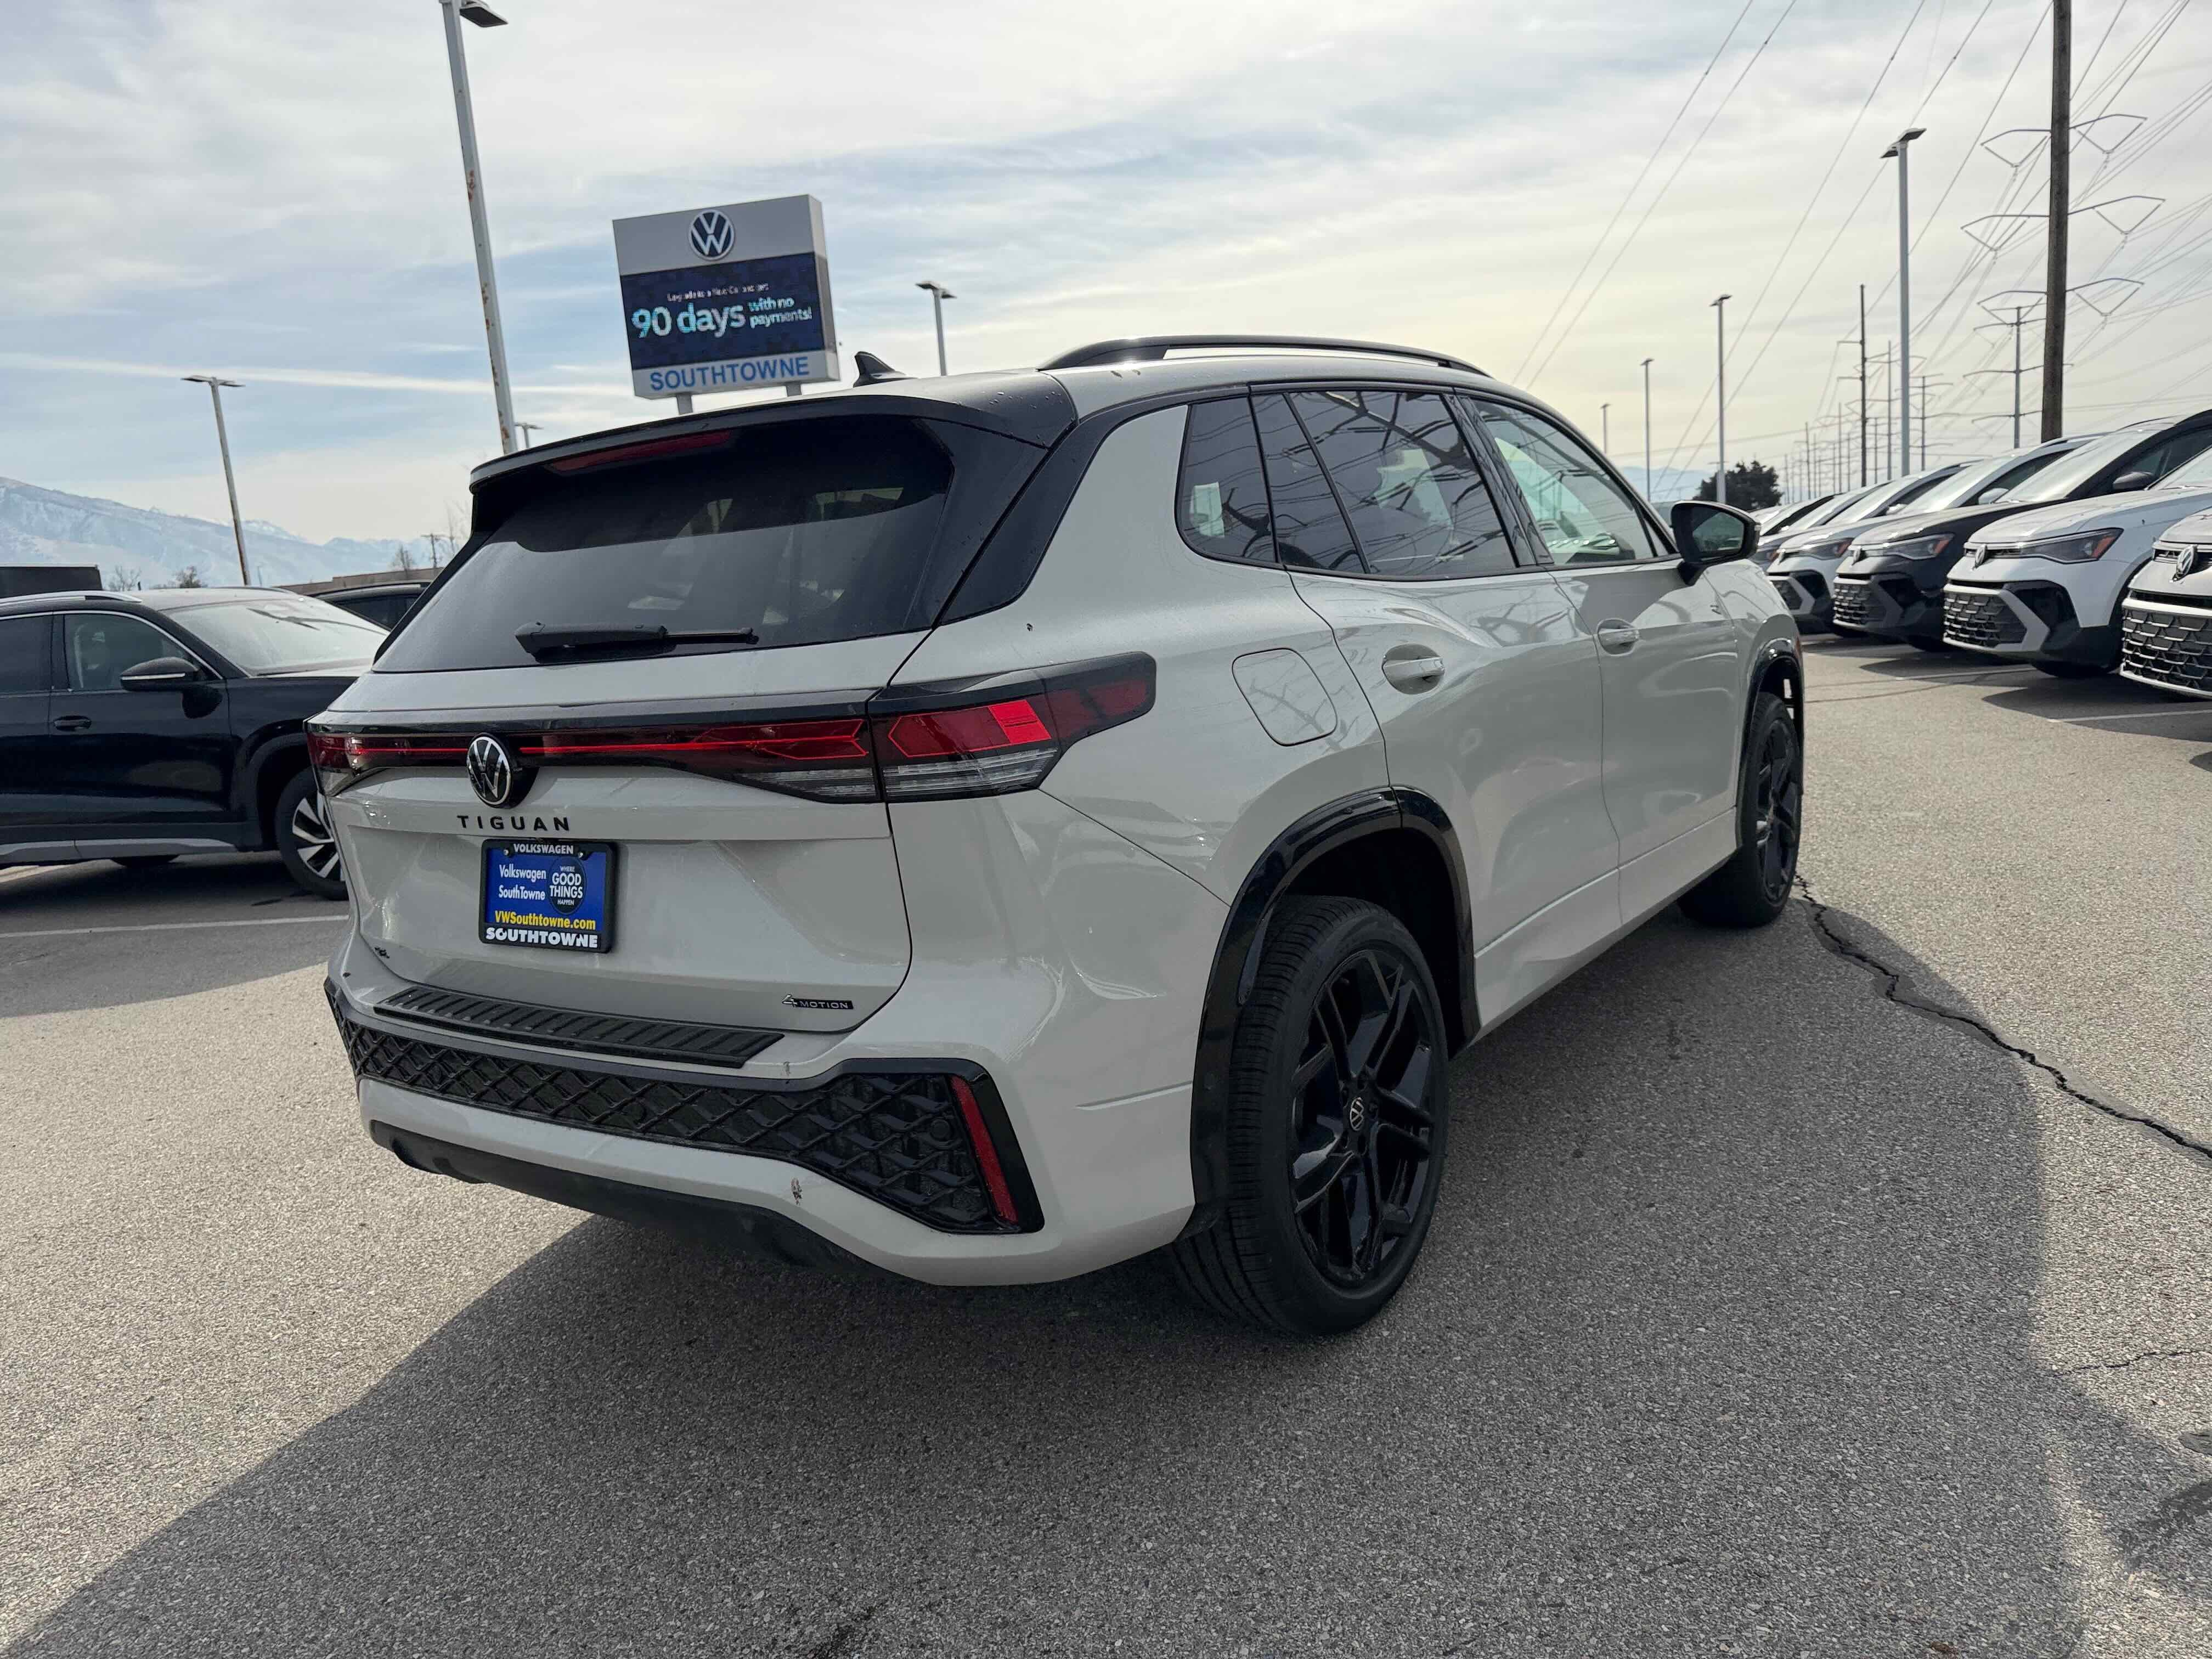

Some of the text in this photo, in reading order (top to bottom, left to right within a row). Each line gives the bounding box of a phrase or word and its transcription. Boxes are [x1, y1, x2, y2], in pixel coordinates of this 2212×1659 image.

[689, 210, 734, 260] VW
[748, 297, 795, 313] with no
[631, 302, 746, 338] 90 days
[749, 307, 812, 329] payments!
[650, 356, 810, 391] SOUTHTOWNE
[457, 815, 570, 832] TIGUAN
[514, 843, 574, 855] VOLKSWAGEN
[499, 864, 547, 882] Volkswagen
[551, 872, 582, 885] GOOD
[498, 884, 546, 901] SouthTowne
[549, 885, 584, 899] THINGS
[495, 910, 596, 930] VWSouthtowne.com
[486, 927, 598, 949] SOUTHTOWNE
[782, 994, 849, 1009] 4MOTION
